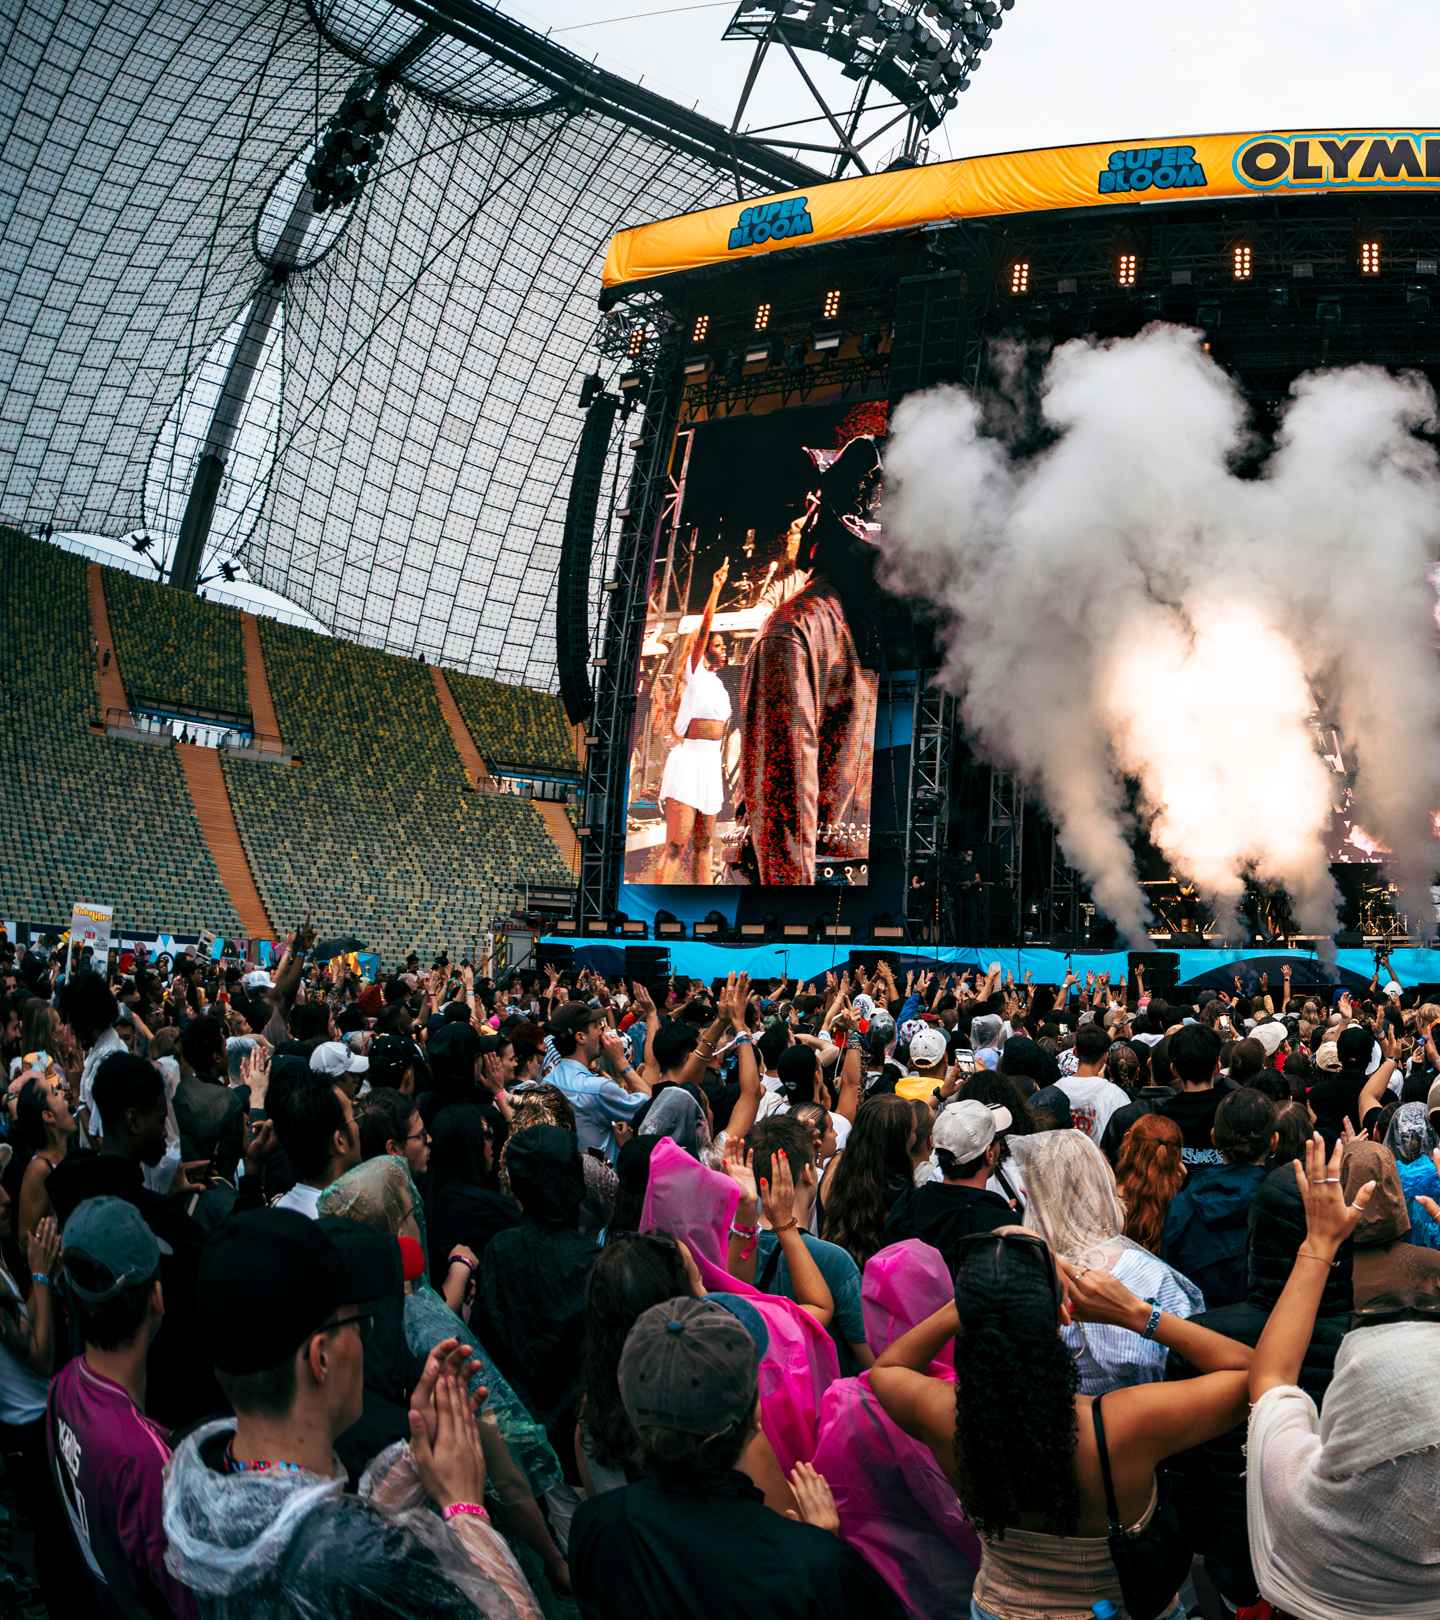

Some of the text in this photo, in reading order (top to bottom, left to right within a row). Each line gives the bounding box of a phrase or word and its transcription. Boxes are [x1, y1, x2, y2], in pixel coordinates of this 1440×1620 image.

[1109, 146, 1195, 171] SUPER
[1099, 164, 1207, 193] BLOOM
[739, 197, 809, 228] SUPER
[729, 214, 813, 249] BLOOM
